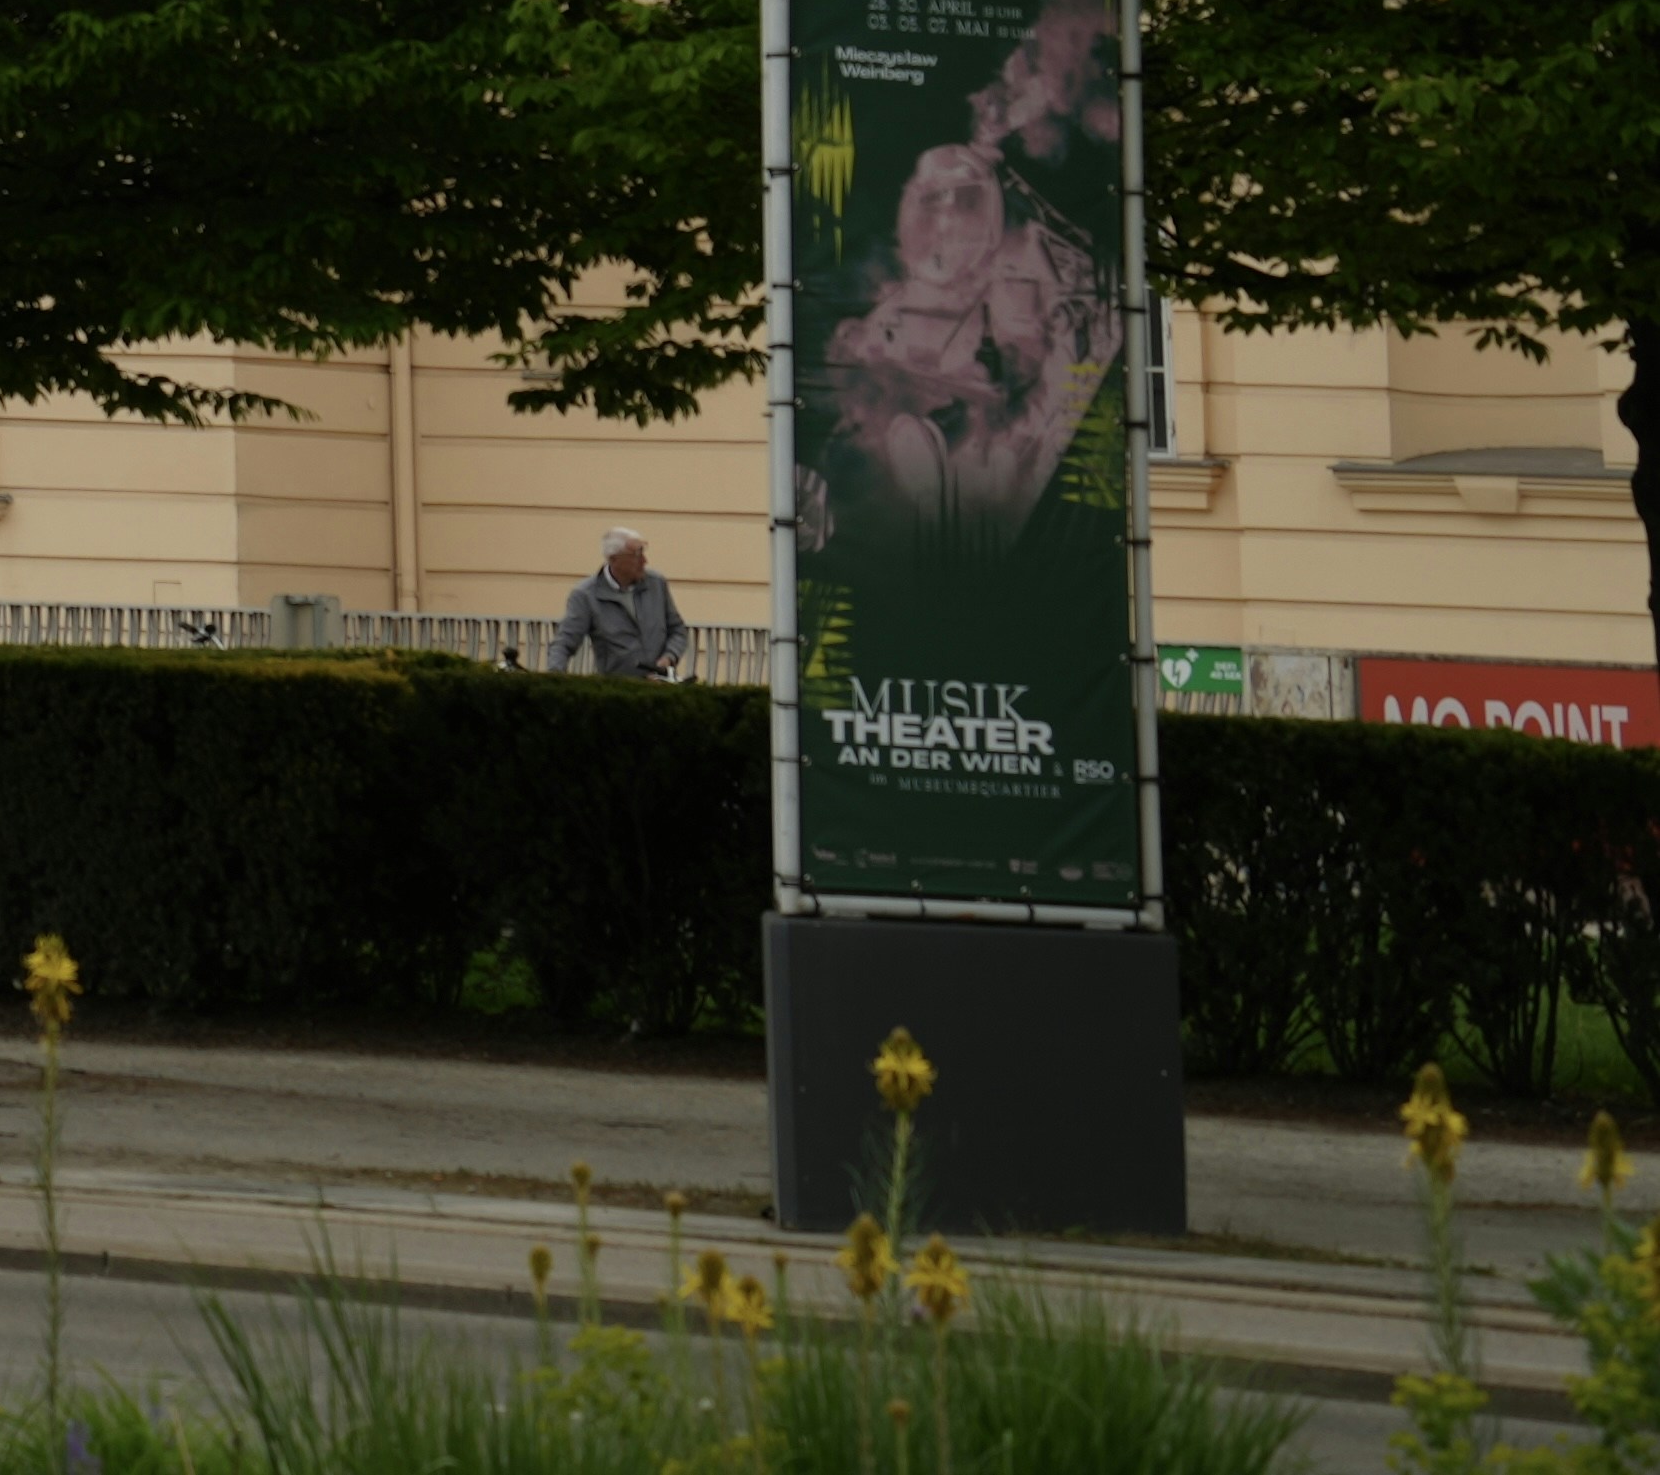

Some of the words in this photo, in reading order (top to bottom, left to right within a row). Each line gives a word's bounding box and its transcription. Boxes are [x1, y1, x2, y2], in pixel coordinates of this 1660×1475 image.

[955, 19, 991, 38] MAI
[839, 62, 925, 87] Weinberg
[849, 675, 1029, 722] MUSIK
[822, 709, 1055, 755] THEATER
[838, 744, 880, 767] AN
[890, 749, 952, 771] DER
[958, 752, 1042, 775] WIEN
[897, 776, 1063, 798] MUSEUMSQUARTIER
